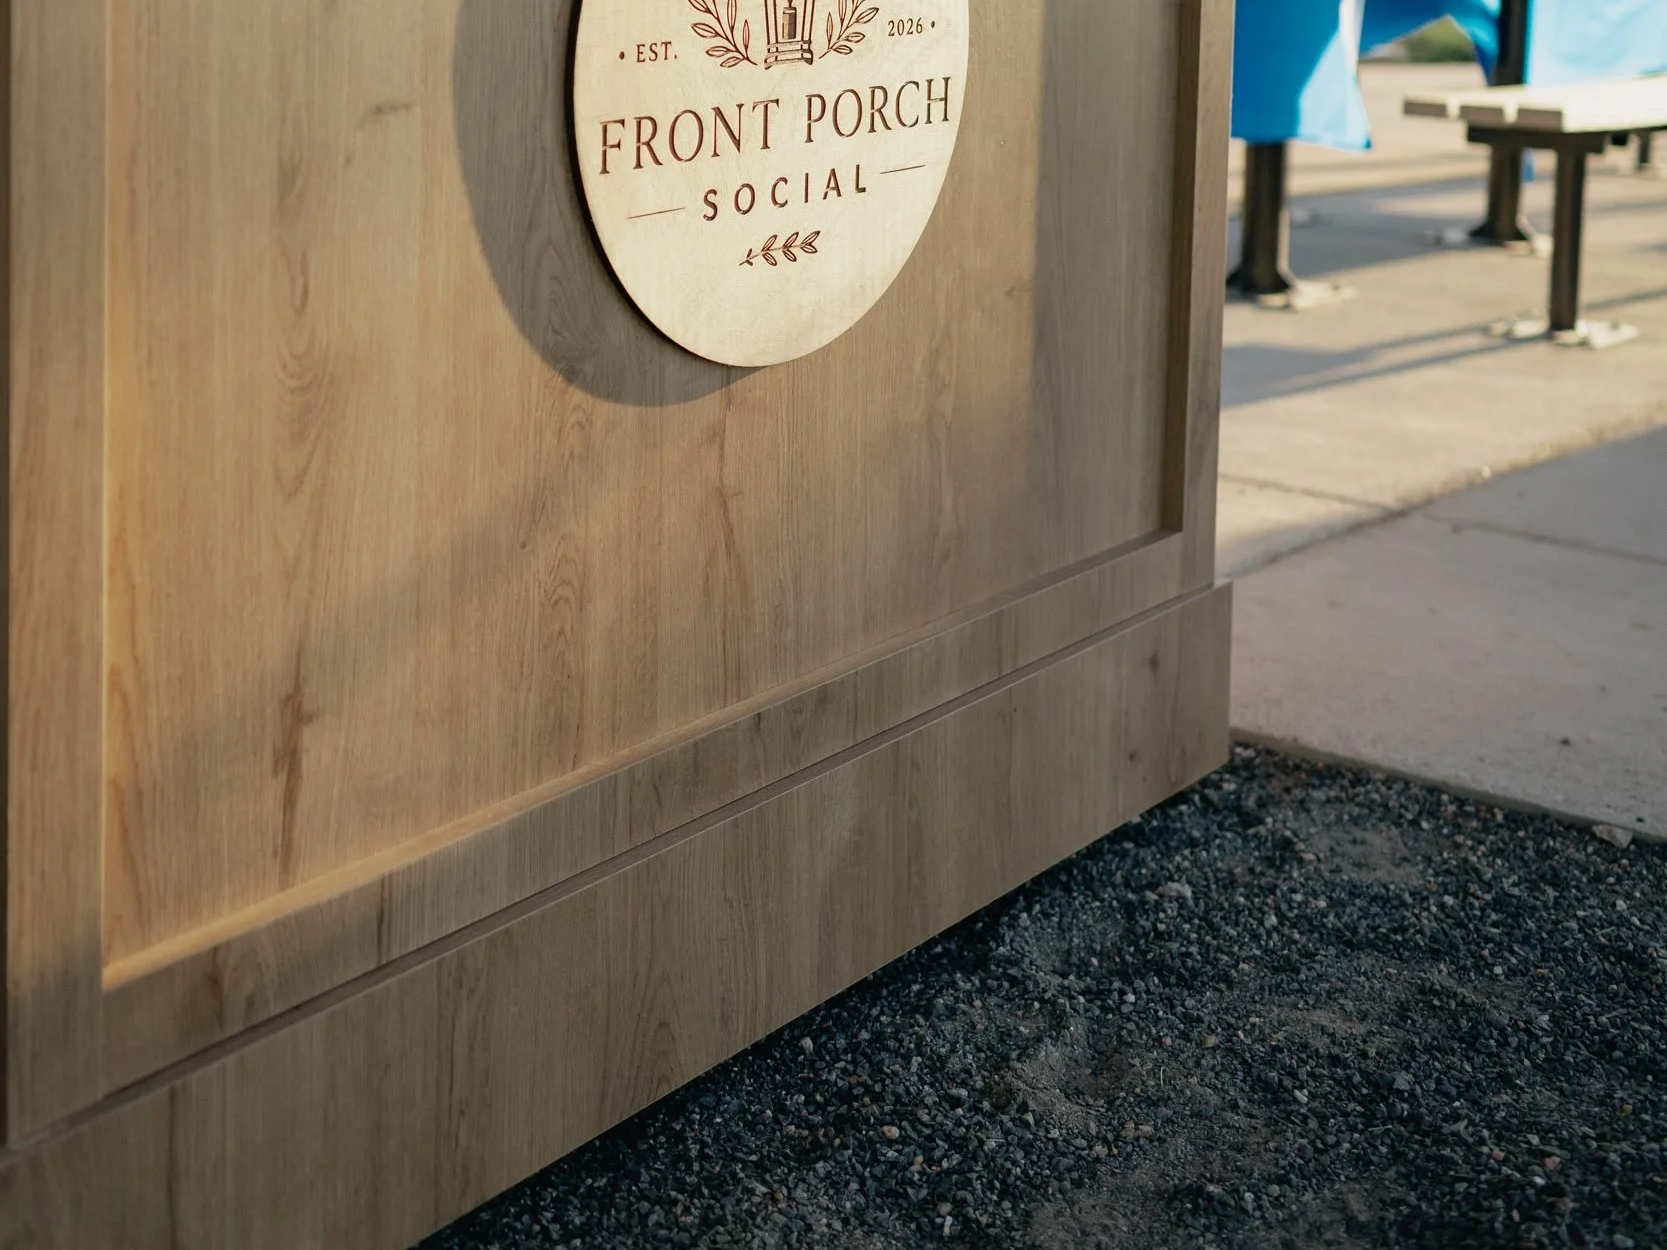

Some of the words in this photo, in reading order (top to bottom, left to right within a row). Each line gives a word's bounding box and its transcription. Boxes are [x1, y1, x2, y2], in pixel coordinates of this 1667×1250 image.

[636, 41, 678, 63] EST.
[887, 16, 923, 37] 2026
[598, 98, 780, 176] FRONT
[804, 76, 951, 144] PORCH
[702, 163, 867, 223] SOCIAL
